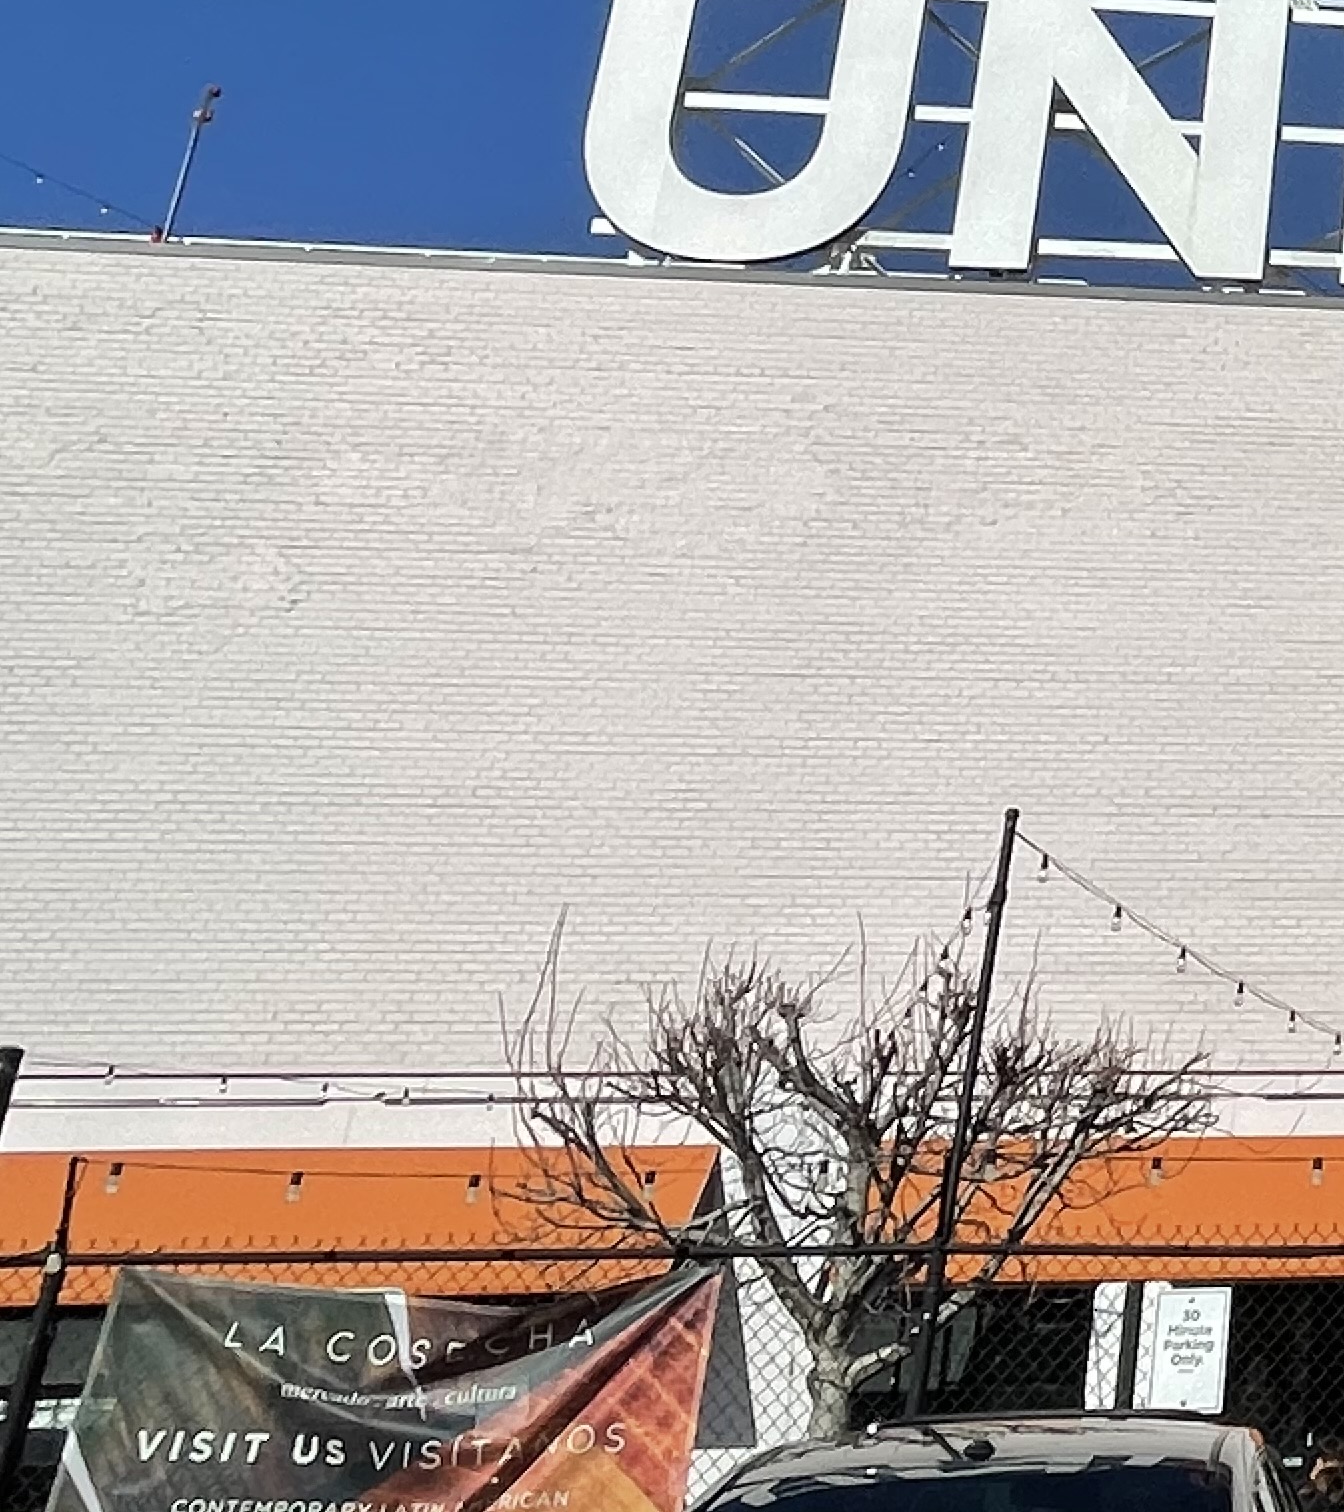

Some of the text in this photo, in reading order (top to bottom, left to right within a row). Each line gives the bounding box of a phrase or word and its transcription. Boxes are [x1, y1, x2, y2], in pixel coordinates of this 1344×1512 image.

[224, 1319, 594, 1369] LA COSECHA
[1163, 1339, 1215, 1353] Parking
[137, 1429, 270, 1463] VISIT
